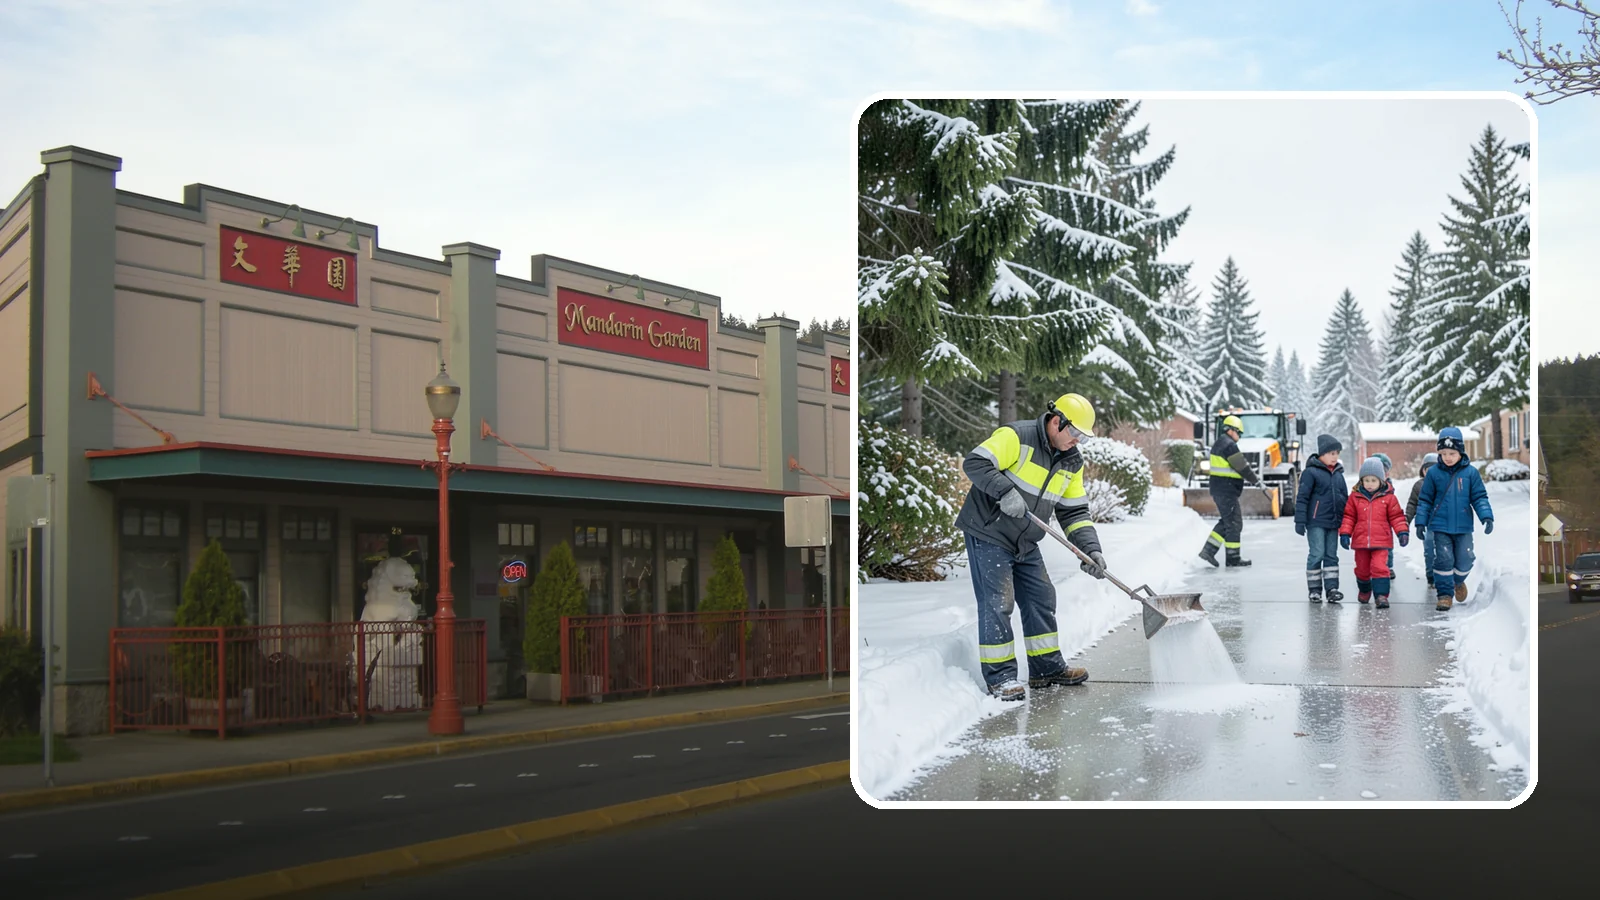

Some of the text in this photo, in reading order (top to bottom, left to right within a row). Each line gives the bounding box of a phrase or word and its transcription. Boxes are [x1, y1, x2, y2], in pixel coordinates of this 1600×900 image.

[231, 235, 346, 291] 文華園
[564, 302, 701, 352] Mandarin Garden
[503, 565, 527, 578] OPEN
